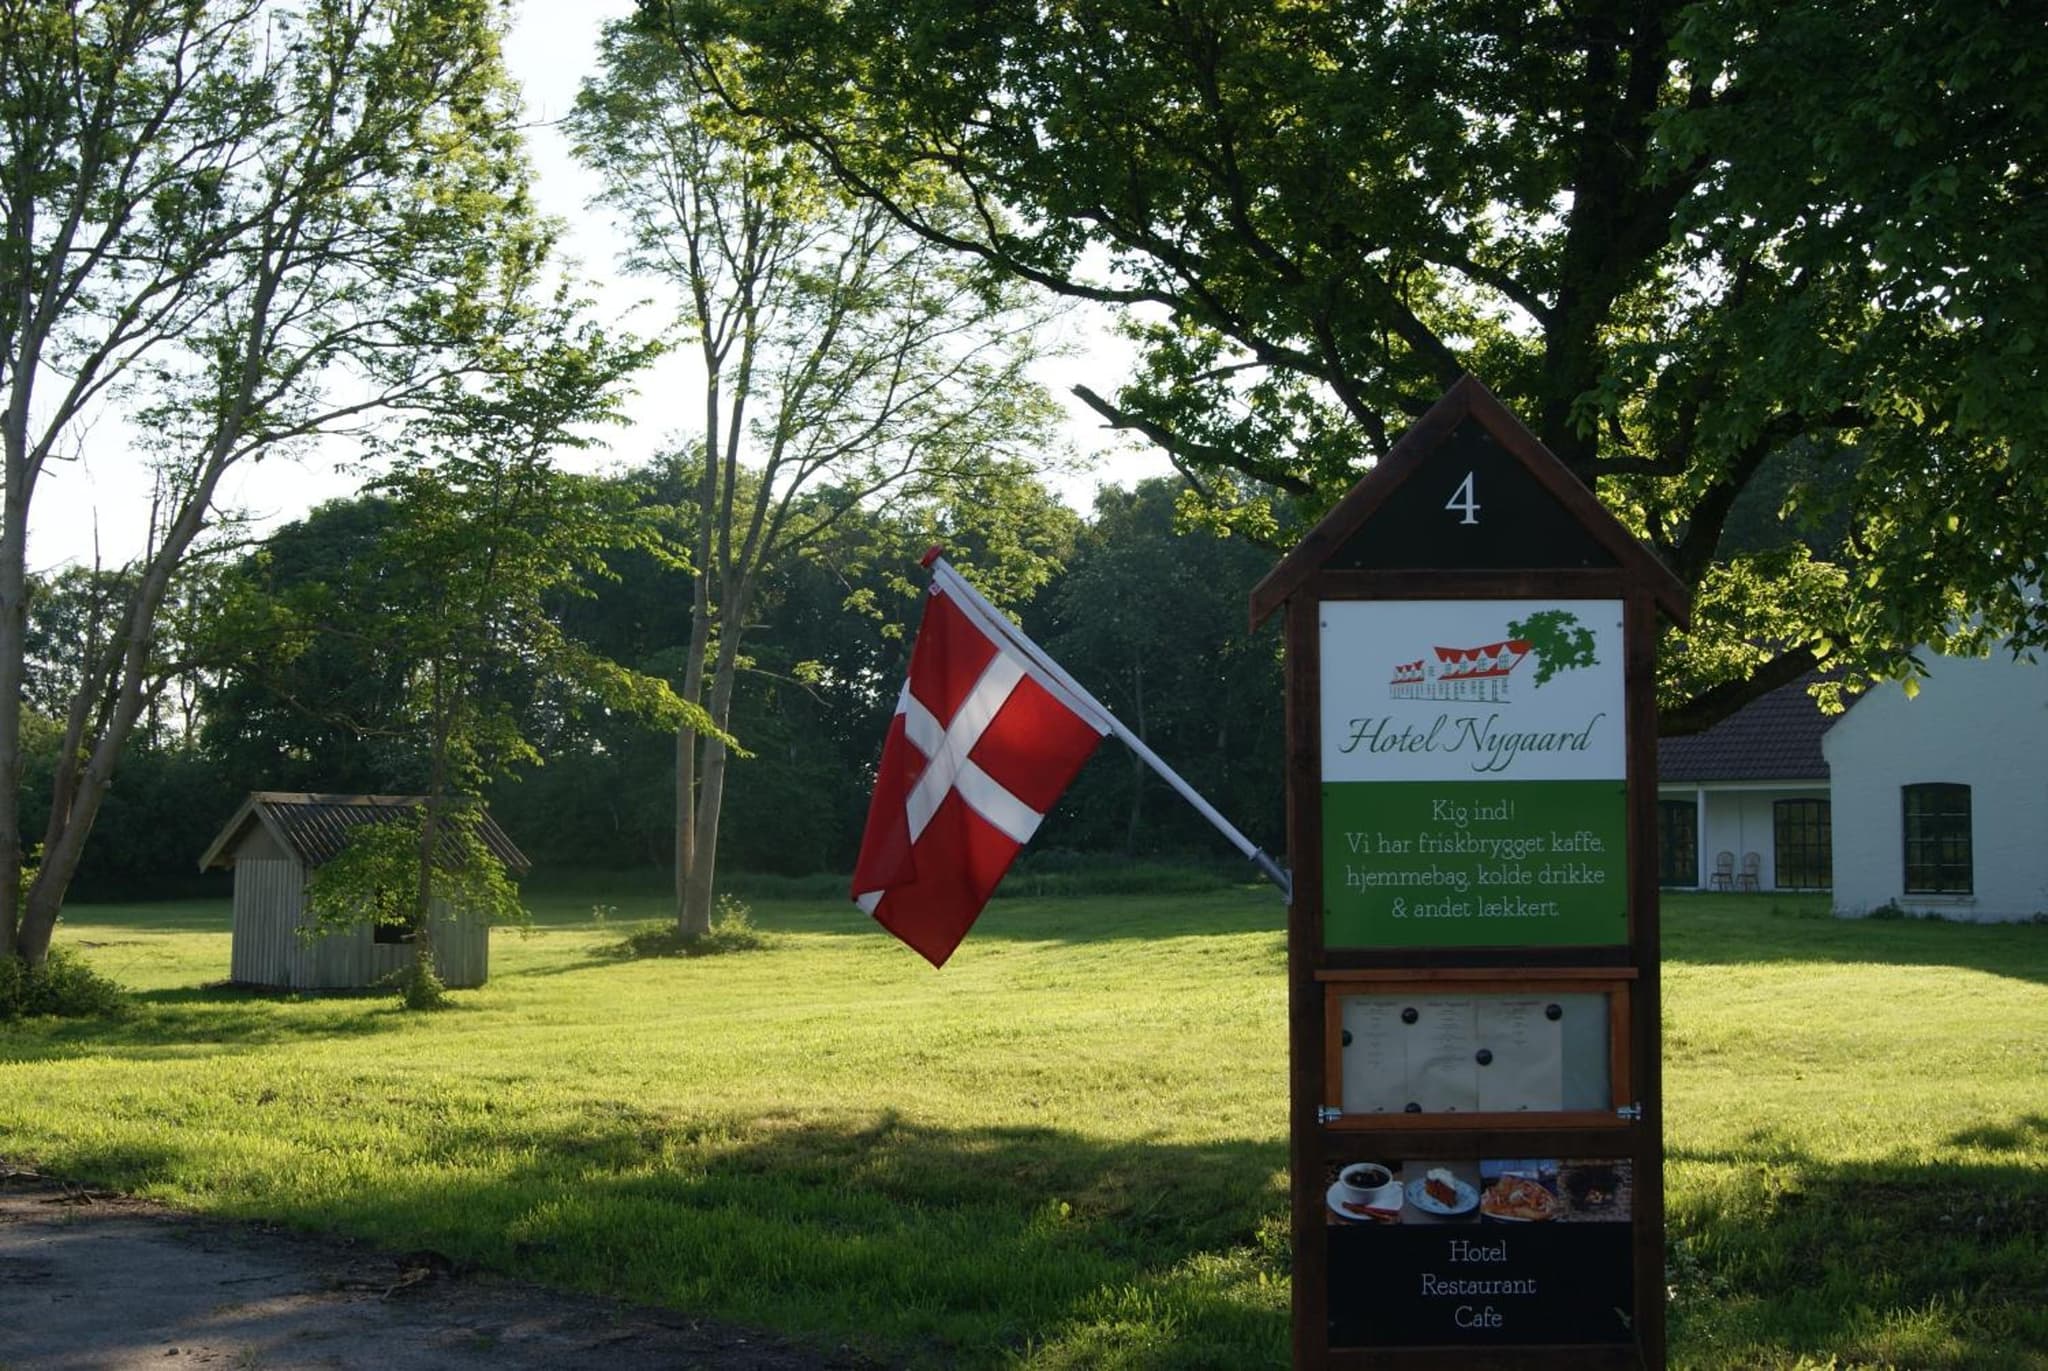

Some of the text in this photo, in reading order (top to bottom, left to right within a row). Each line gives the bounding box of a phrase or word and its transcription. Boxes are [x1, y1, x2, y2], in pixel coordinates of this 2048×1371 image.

[1445, 471, 1481, 525] 4
[1339, 712, 1606, 772] Hotel Nygaard
[1432, 800, 1468, 828] Kig
[1345, 833, 1369, 853] Vi
[1377, 833, 1411, 853] har
[1419, 832, 1544, 860] friskbrygget
[1478, 865, 1532, 885] kolde
[1538, 863, 1605, 885] drikke
[1391, 897, 1408, 918] &
[1414, 897, 1472, 918] andet
[1449, 1240, 1508, 1262] Hotel
[1421, 1273, 1537, 1295] Restaurant
[1454, 1305, 1504, 1328] Cafe
